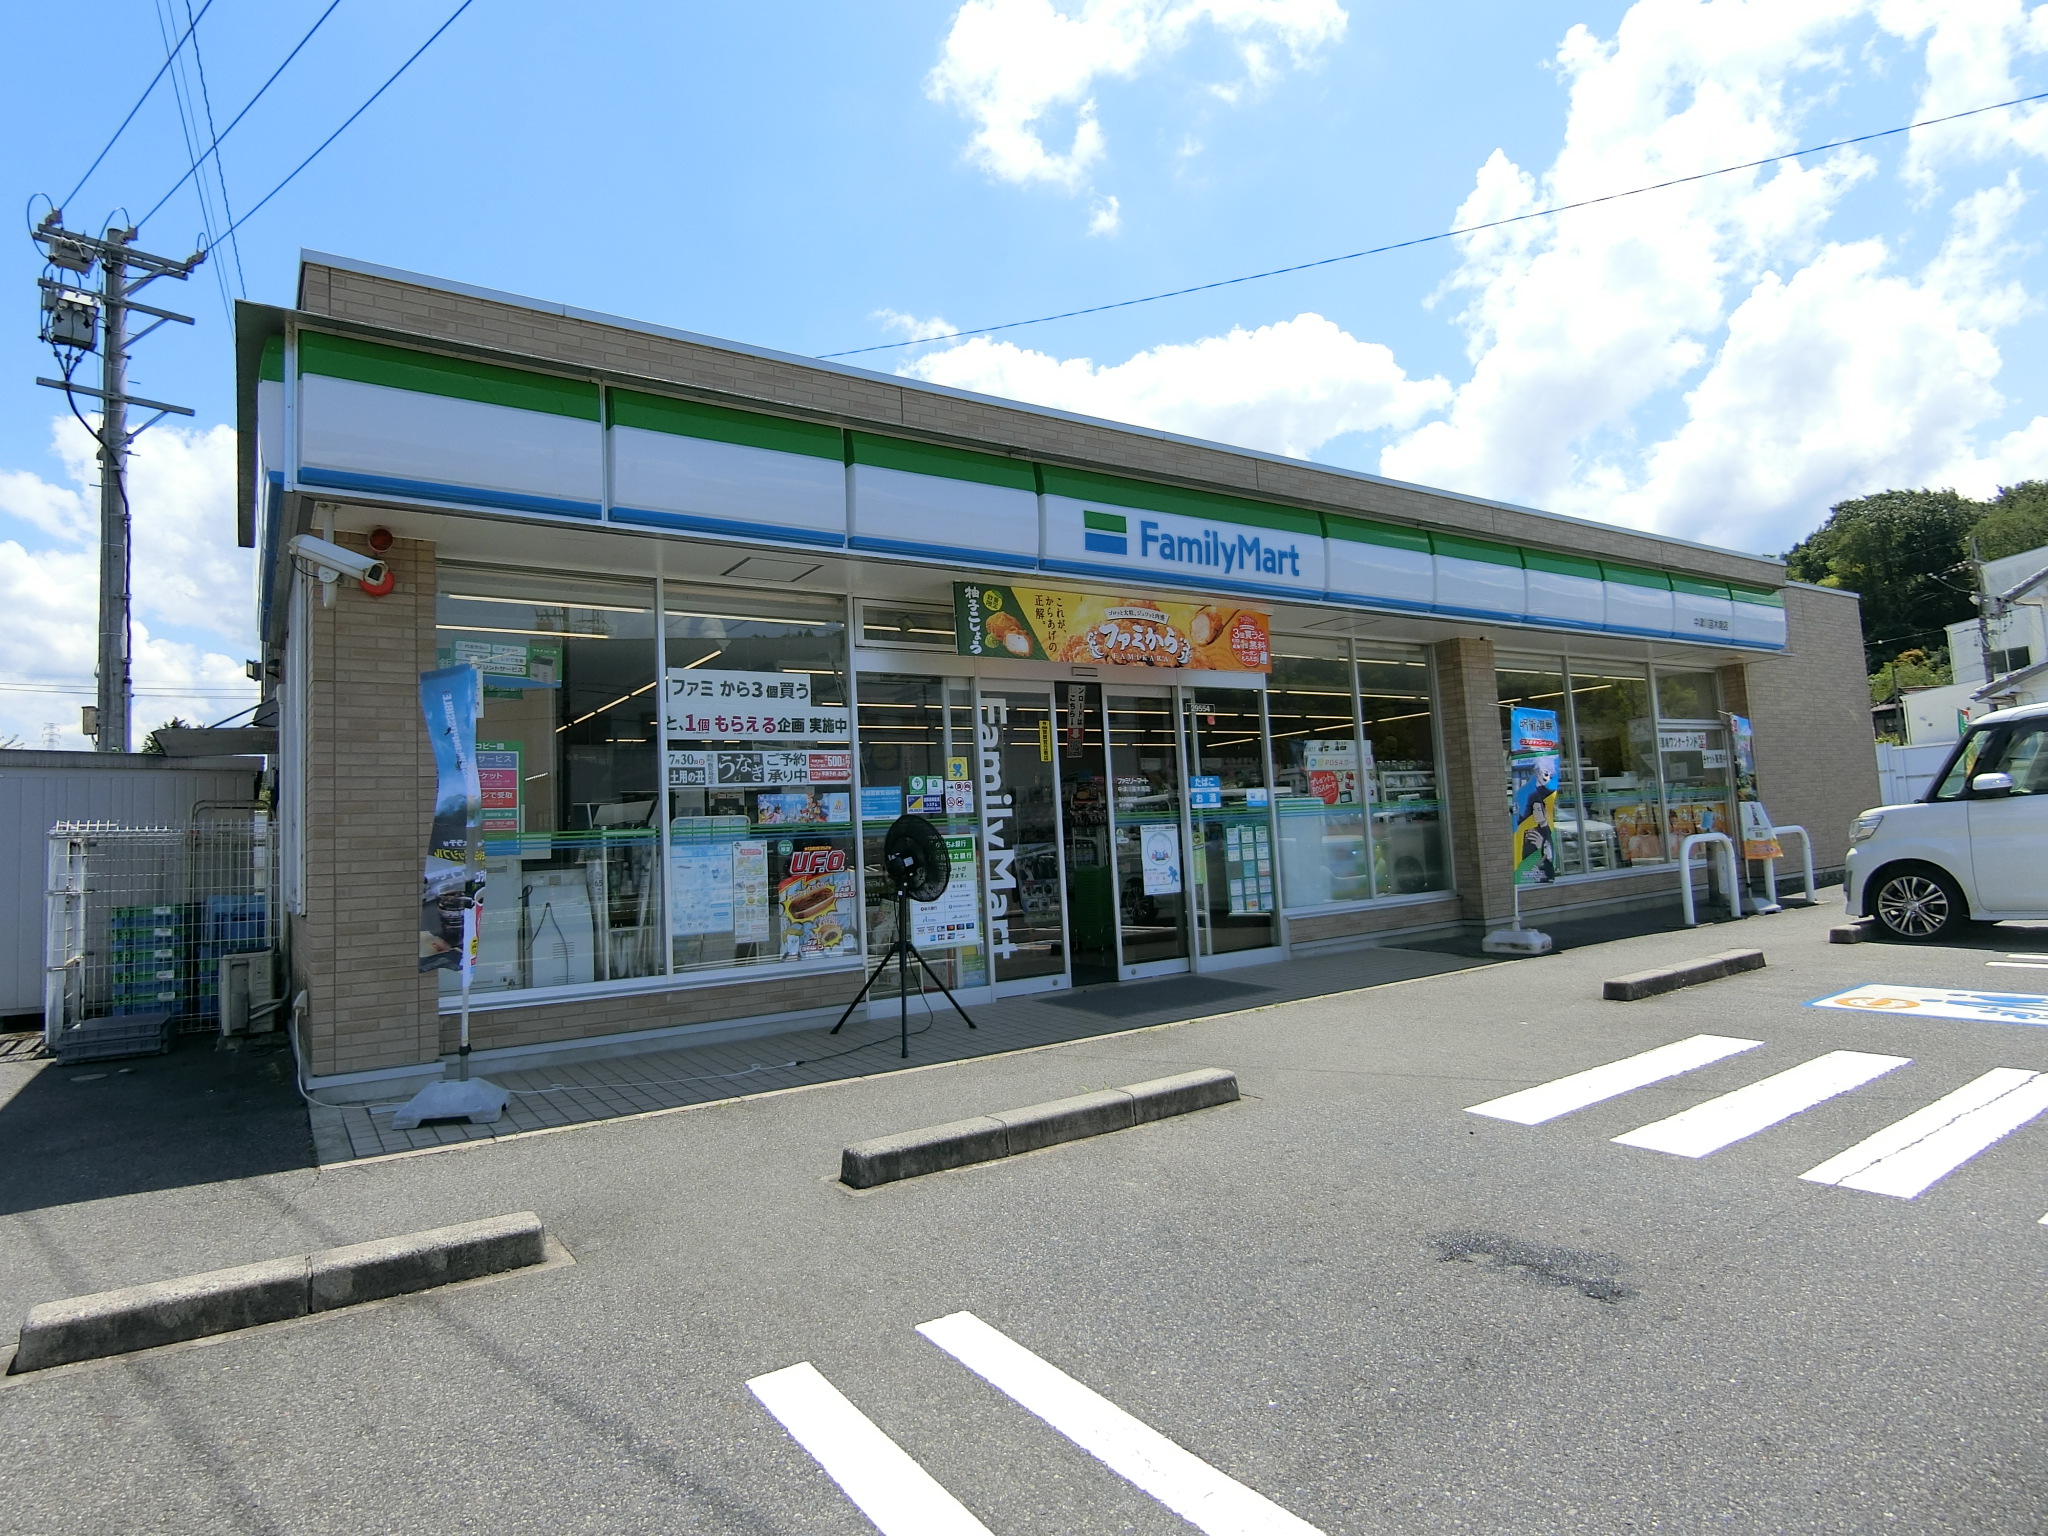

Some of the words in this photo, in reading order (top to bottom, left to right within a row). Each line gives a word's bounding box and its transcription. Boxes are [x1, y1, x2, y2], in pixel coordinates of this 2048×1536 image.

[1140, 520, 1300, 577] FamilyMart
[965, 586, 982, 655] 柚子こしょう
[1034, 594, 1046, 625] 正解。
[1056, 597, 1067, 633] これが、
[1046, 597, 1057, 653] からあげの
[1100, 623, 1178, 654] ファミから
[1113, 653, 1170, 663] FAMIKARA
[1190, 704, 1211, 713] 29554
[718, 754, 763, 782] うなぎ
[767, 753, 807, 767] ご予約
[670, 769, 706, 785] 土用の丑
[767, 769, 808, 783] 承り中
[1116, 777, 1150, 785] ファミリーマート
[1194, 777, 1216, 787] たばこ
[981, 698, 1018, 959] FamilyMart
[789, 850, 846, 874] U.F.O.
